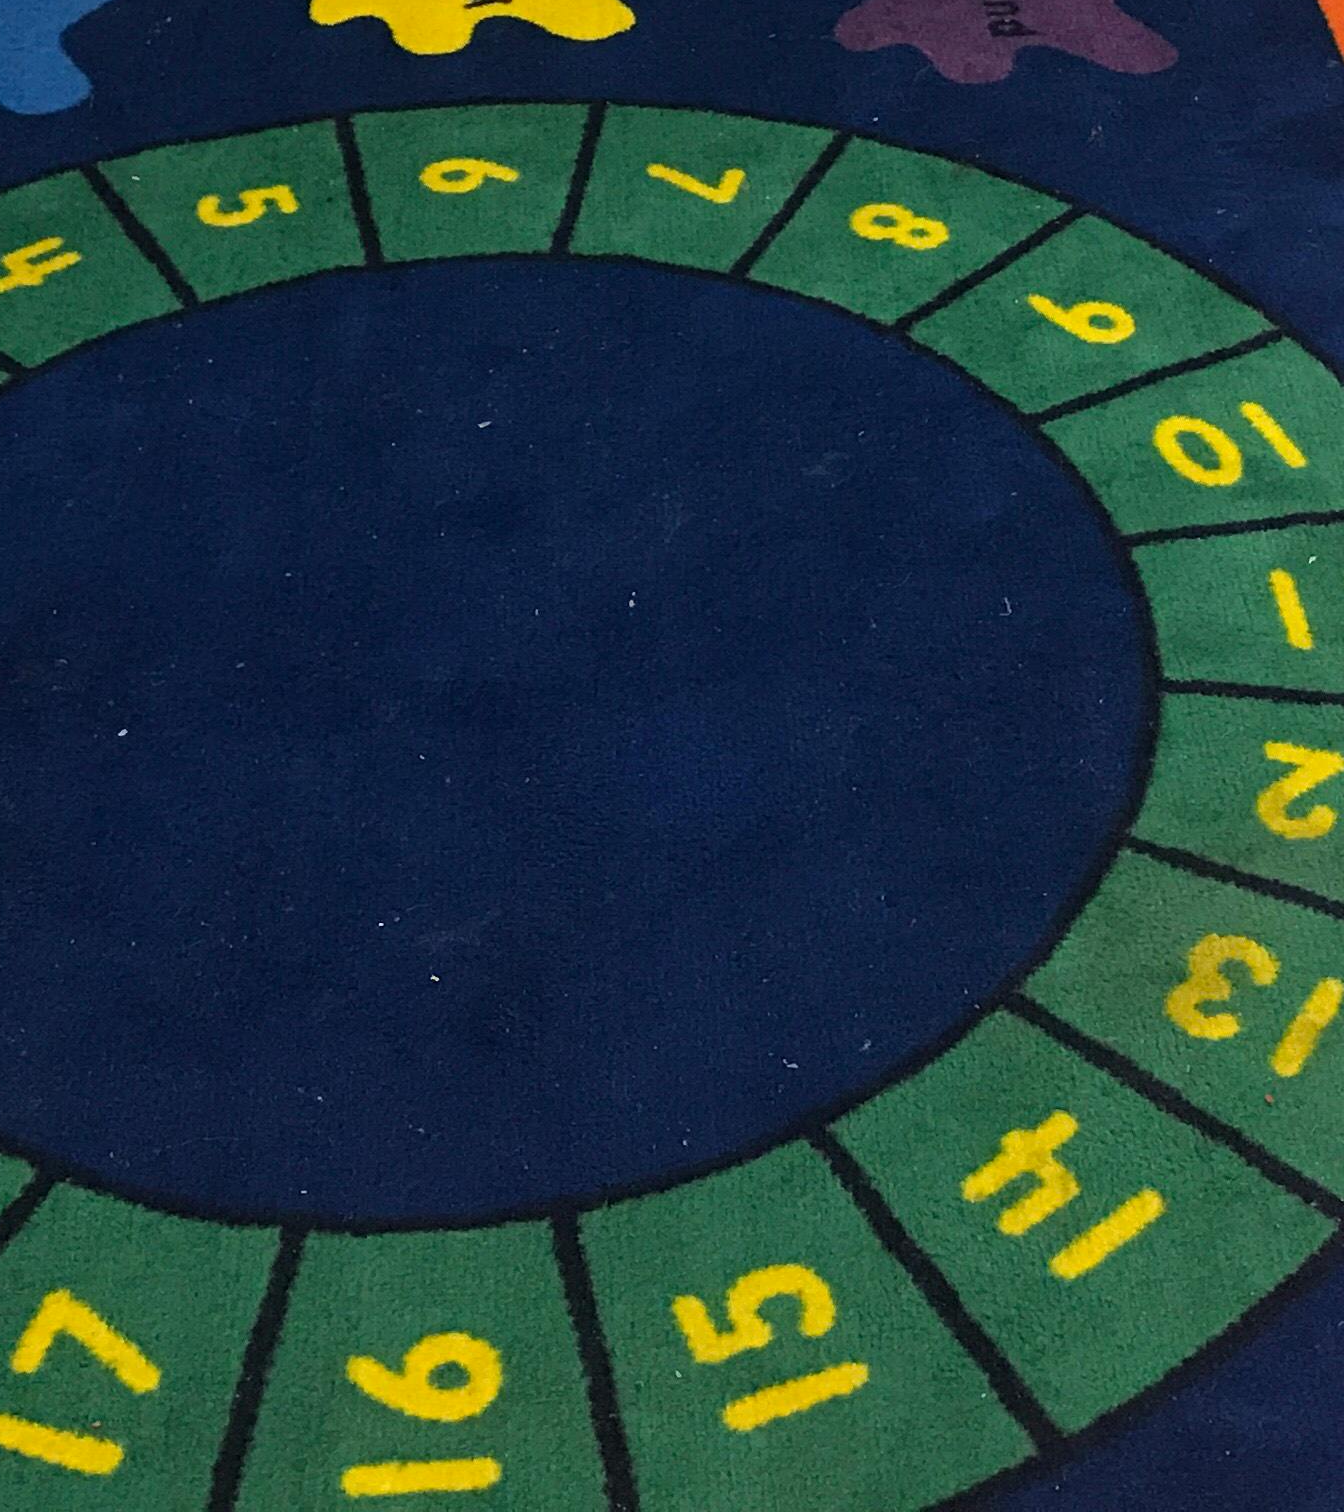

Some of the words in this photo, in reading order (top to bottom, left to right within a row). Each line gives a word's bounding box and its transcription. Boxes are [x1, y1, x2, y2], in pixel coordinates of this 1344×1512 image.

[197, 185, 297, 227] 5
[421, 158, 518, 193] 6
[648, 164, 744, 203] 7
[851, 203, 949, 250] 8
[1029, 295, 1136, 343] 9
[1154, 403, 1306, 486] 10
[1166, 934, 1344, 1076] 13
[963, 1111, 1164, 1278] 14
[672, 1264, 868, 1431] 15
[341, 1332, 502, 1497] 16
